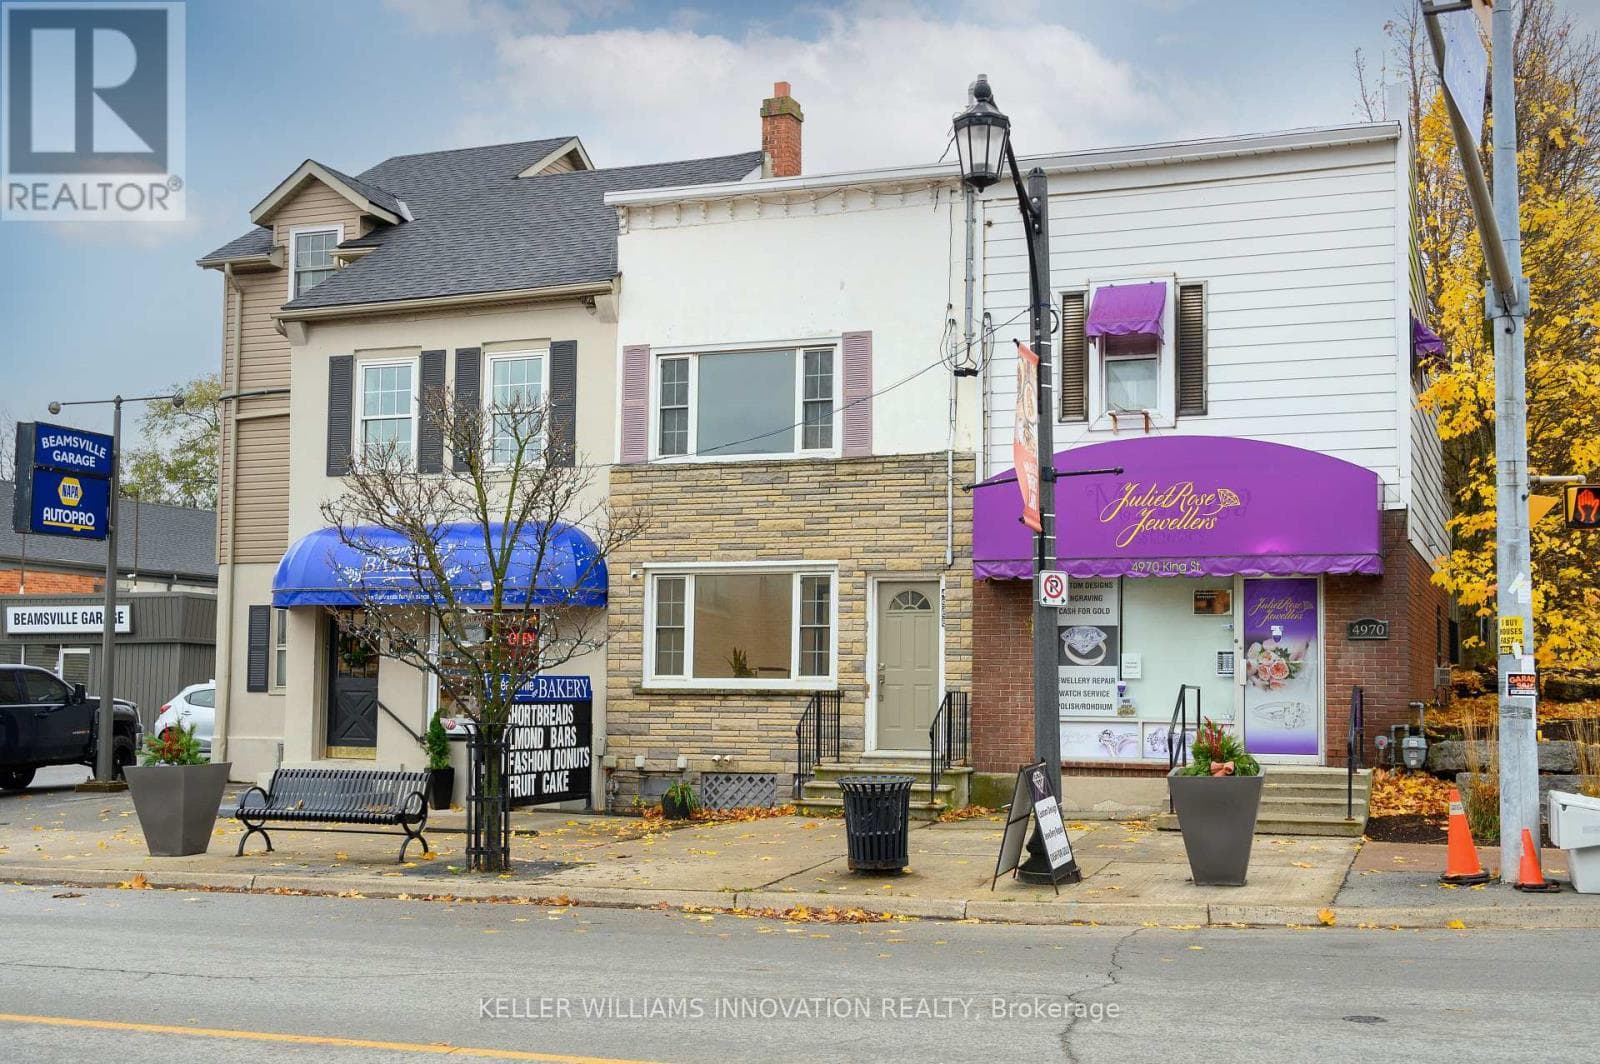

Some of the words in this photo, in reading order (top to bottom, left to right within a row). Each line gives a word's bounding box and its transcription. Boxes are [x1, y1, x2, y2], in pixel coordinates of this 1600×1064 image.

[41, 435, 107, 459] BEAMSVILLE
[52, 450, 96, 468] GARAGE
[61, 484, 80, 500] NAPA
[43, 507, 95, 526] AUTOPRO
[1116, 507, 1217, 547] Jewellers
[1131, 562, 1160, 573] 4970
[1163, 562, 1187, 573] King
[1069, 594, 1103, 602] NGRAVING
[14, 612, 78, 625] BEAMSVILLE
[1058, 607, 1076, 615] CASH
[1078, 607, 1091, 615] FOR
[1092, 607, 1111, 615] GOLD
[1352, 624, 1385, 636] 4970
[539, 679, 589, 698] BAKERY
[1092, 677, 1116, 685] REPAIR
[1082, 690, 1110, 698] SERVICE
[508, 703, 574, 727] HORTBREADS
[550, 726, 577, 748] BARS
[508, 749, 552, 775] FASHION
[554, 746, 590, 770] DONUTS
[510, 773, 536, 798] FRUIT
[542, 770, 569, 794] CAKE
